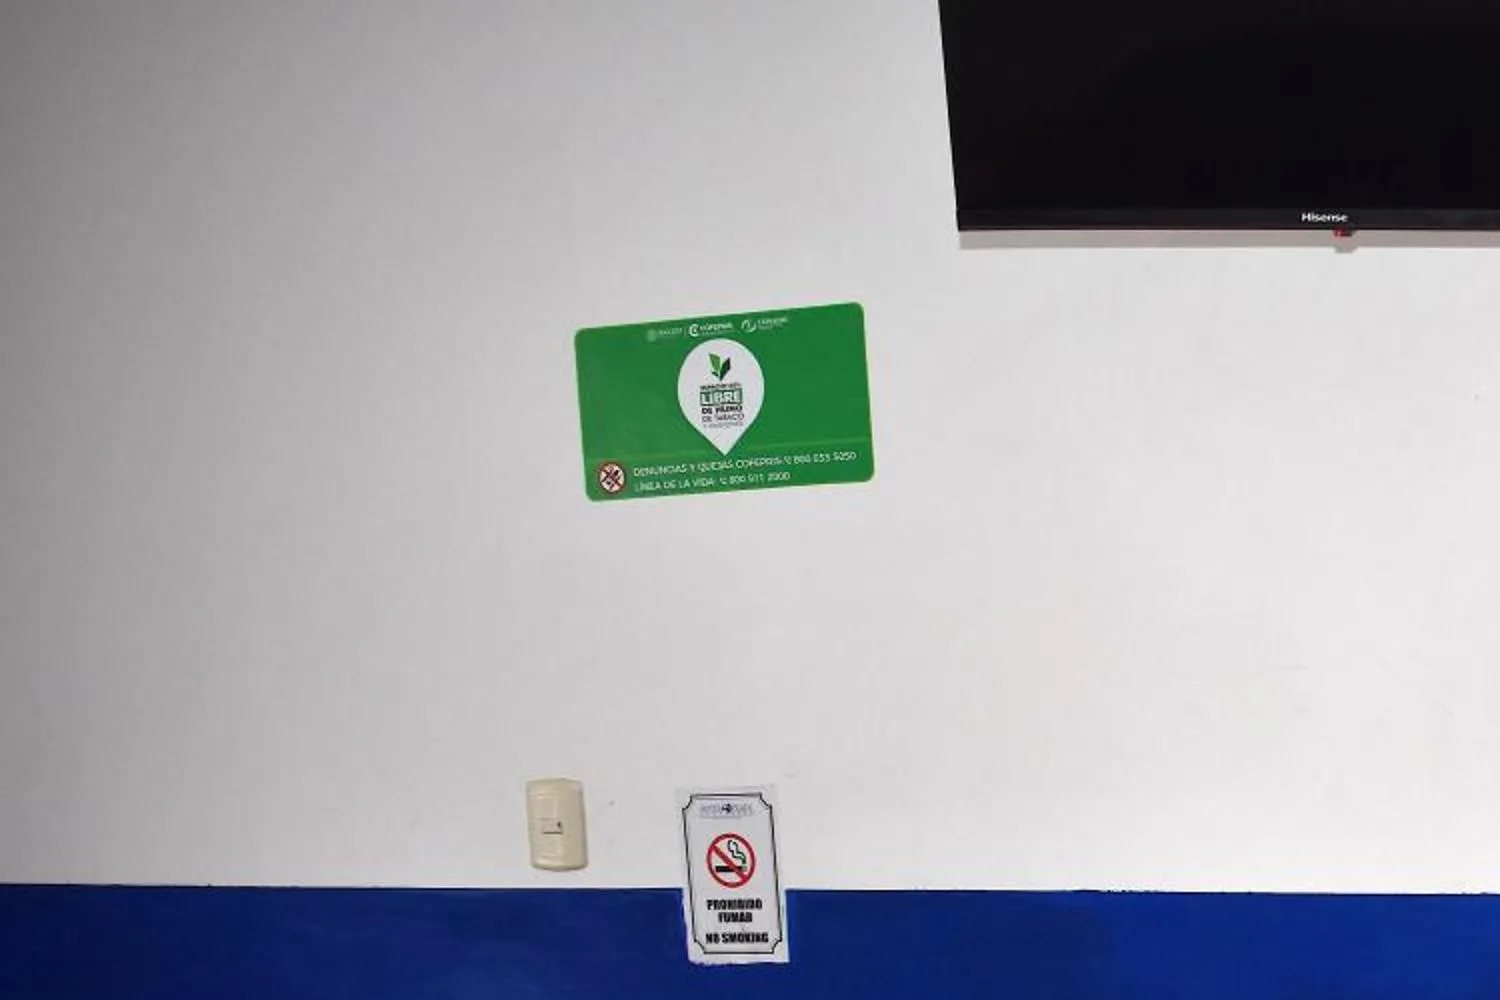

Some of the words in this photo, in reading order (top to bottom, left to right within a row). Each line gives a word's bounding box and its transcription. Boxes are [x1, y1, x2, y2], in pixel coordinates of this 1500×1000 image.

[1301, 212, 1348, 222] Hisense
[701, 391, 742, 405] LIBRE
[634, 464, 687, 477] DENUNCIAS
[663, 480, 677, 489] DE
[680, 479, 691, 489] LA
[706, 898, 763, 911] PROHIBIDO
[718, 911, 753, 923] FUMAR
[705, 932, 720, 944] NO
[721, 931, 769, 944] SMOKING
